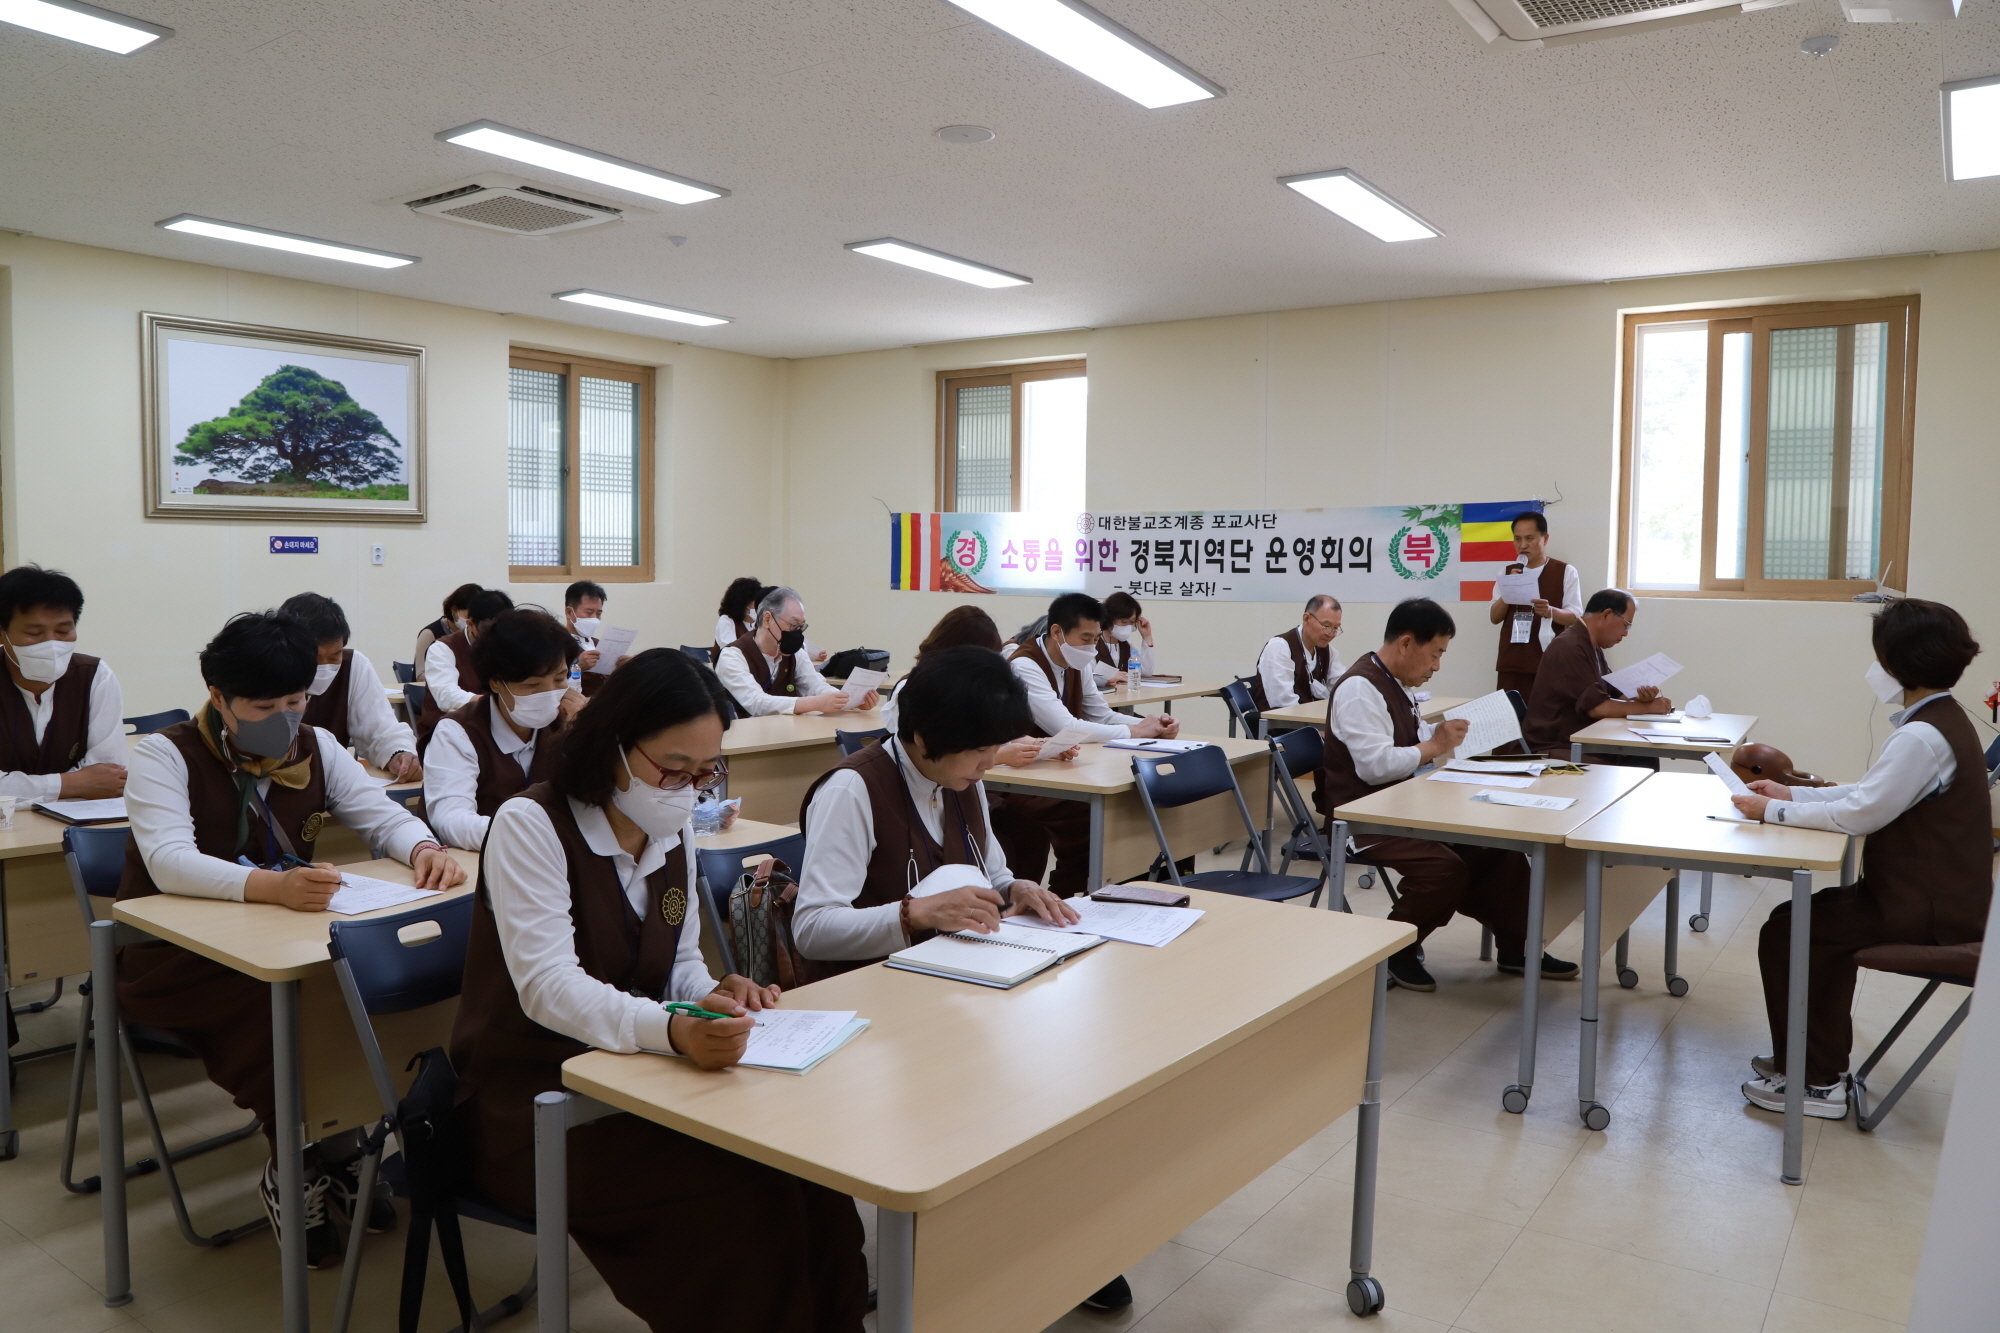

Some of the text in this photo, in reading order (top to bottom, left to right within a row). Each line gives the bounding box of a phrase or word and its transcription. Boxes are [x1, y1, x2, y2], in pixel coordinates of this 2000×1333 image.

[1098, 513, 1278, 531] 대한불교조계종 포교사단
[284, 541, 315, 549] 손대지 마세요
[955, 537, 977, 567] 경
[1001, 535, 1373, 576] 소통을 위한 경북지역단 운영회의
[1403, 533, 1435, 568] 북
[1128, 580, 1174, 596] 붓다로
[1178, 580, 1217, 597] 살자!
